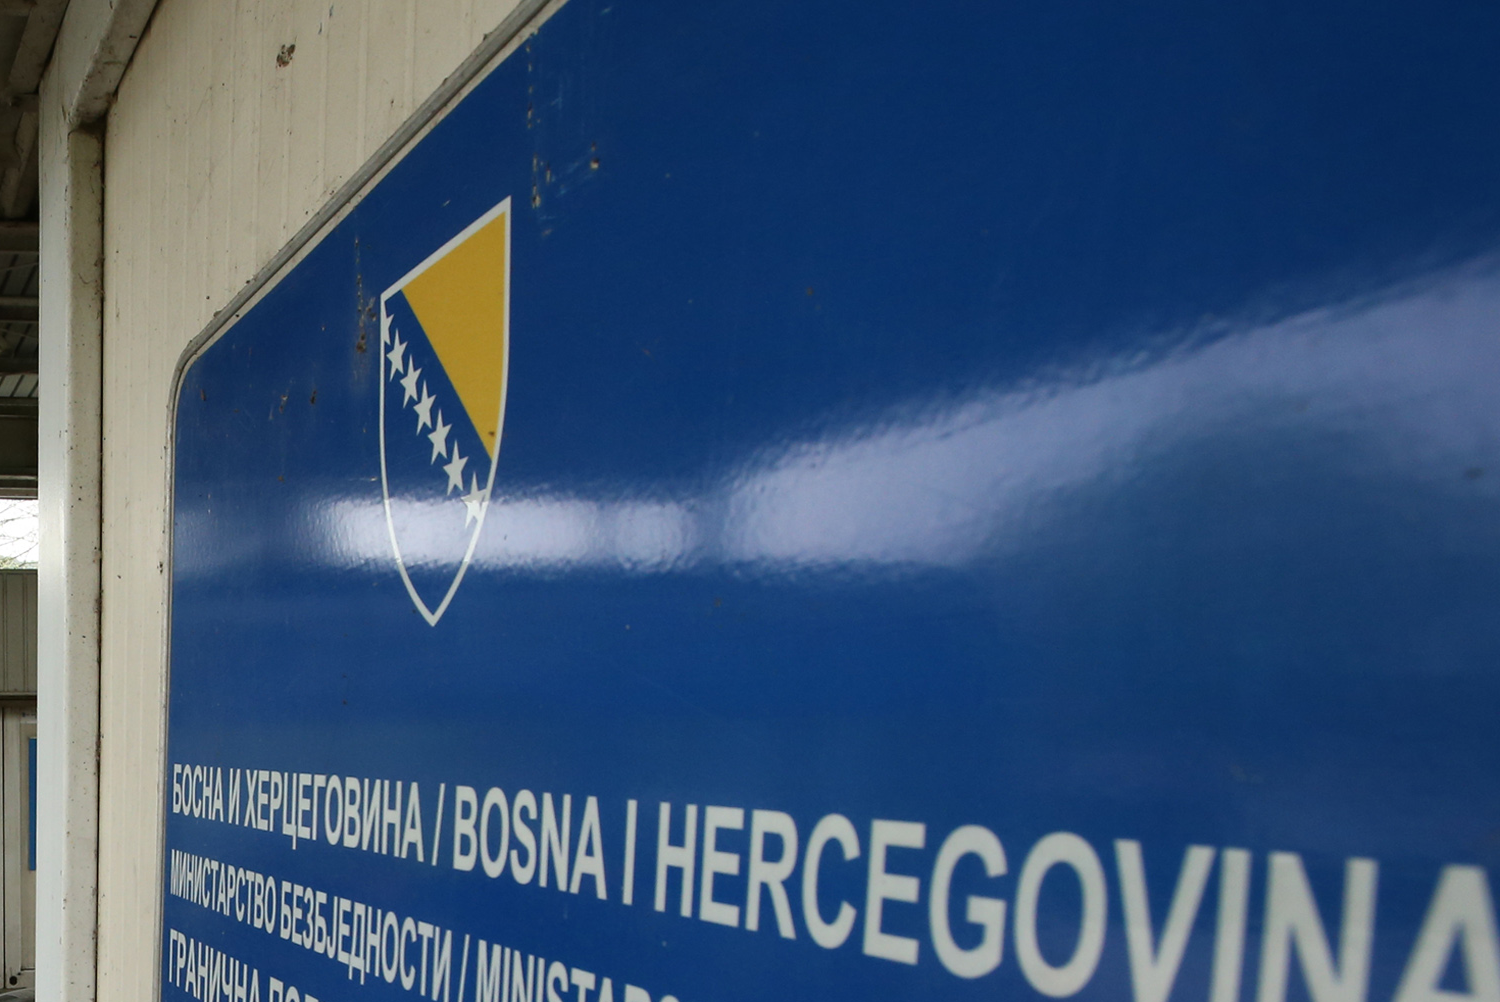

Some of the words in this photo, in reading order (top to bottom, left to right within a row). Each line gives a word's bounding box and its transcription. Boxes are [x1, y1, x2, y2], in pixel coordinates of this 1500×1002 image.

[173, 764, 224, 822] БОСНА
[228, 768, 240, 825] И
[244, 769, 425, 862] ХЕРЦЕГОВИНА
[432, 783, 445, 866] /
[453, 786, 607, 900] BOSNA
[623, 799, 637, 905] I
[171, 849, 277, 933] МИНИСТАРСТВО
